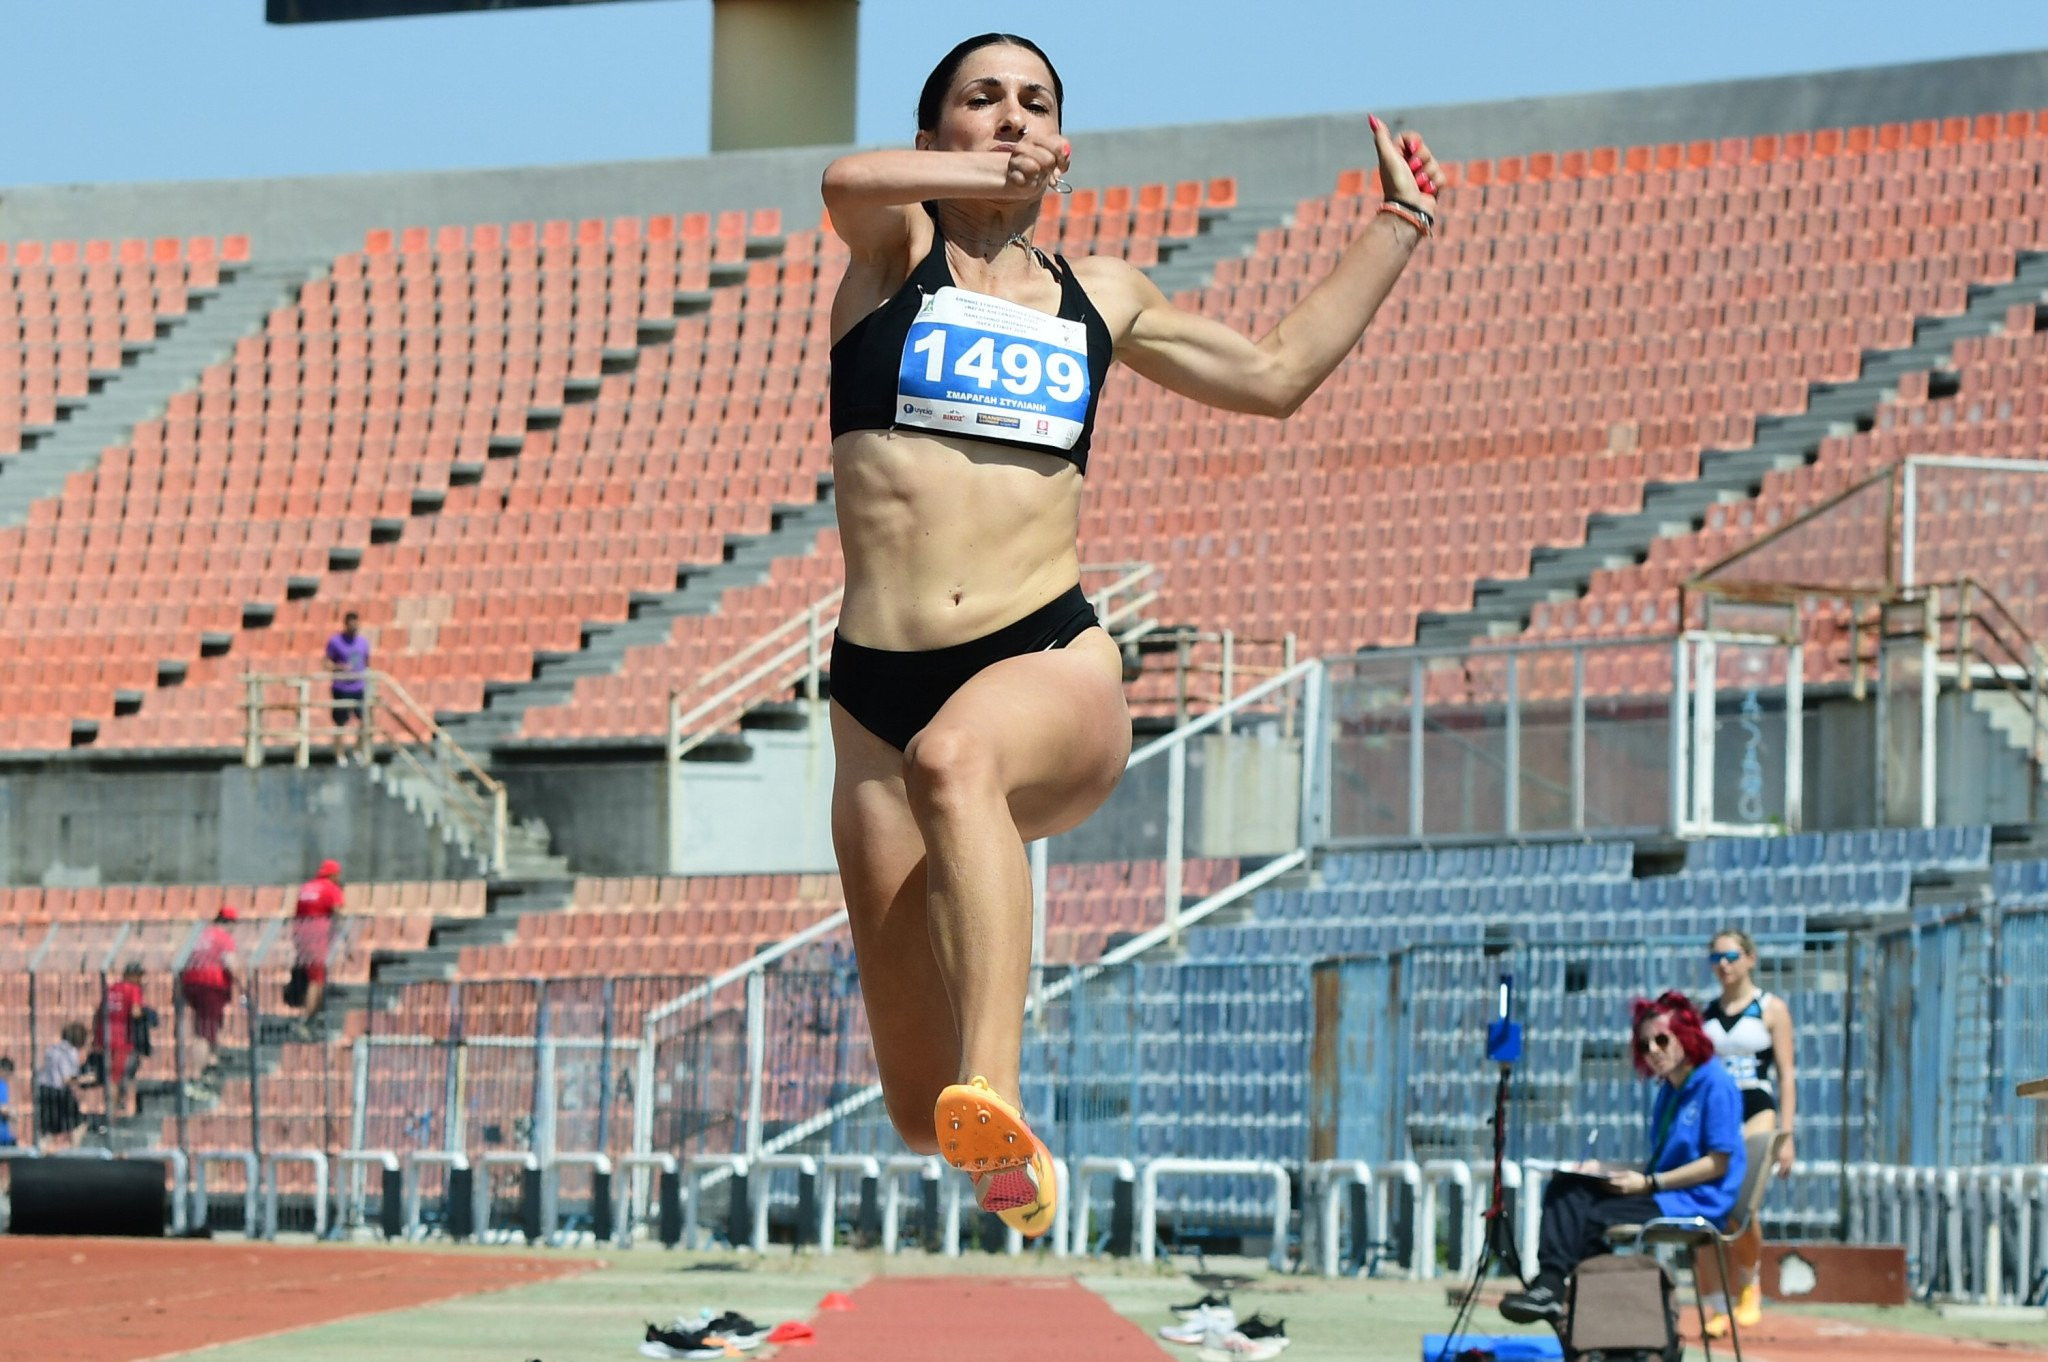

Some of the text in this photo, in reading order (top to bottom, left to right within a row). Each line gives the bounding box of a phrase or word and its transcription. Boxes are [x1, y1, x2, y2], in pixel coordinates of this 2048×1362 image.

[914, 329, 1085, 403] 1499
[946, 390, 1047, 411] ΣΜΑΡΑΓΔΗ ΣΤΥΛΙΑΝΗ
